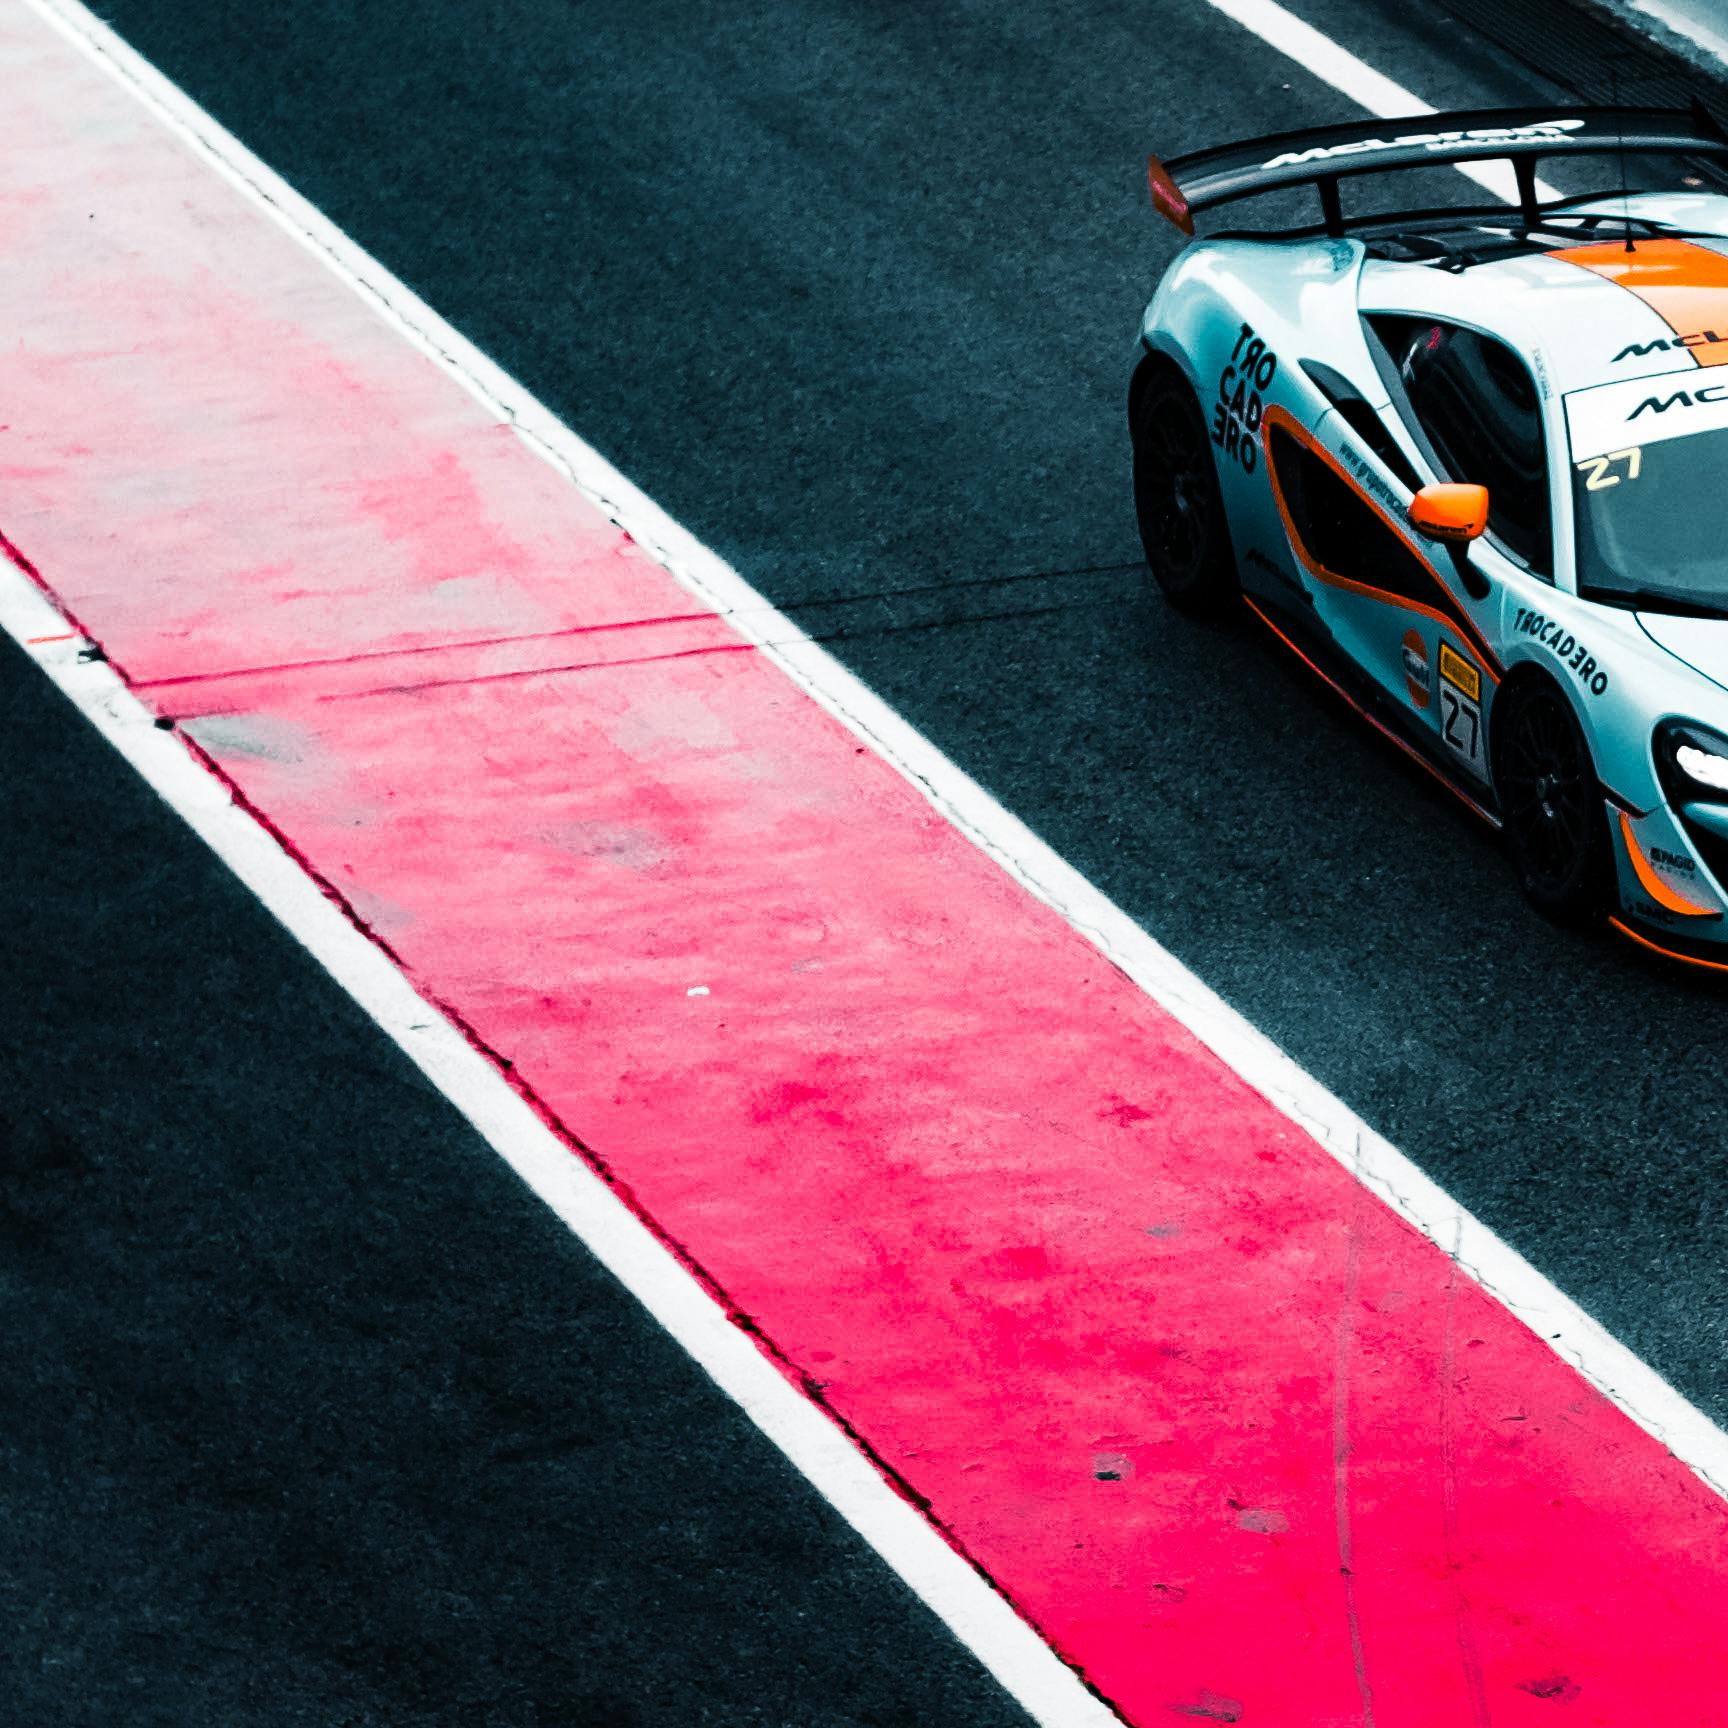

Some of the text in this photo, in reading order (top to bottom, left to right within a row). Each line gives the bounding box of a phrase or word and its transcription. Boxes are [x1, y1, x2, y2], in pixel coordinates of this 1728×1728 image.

[1261, 118, 1586, 169] McLaren
[1219, 364, 1263, 432] CAD
[1577, 446, 1645, 493] 27
[1442, 688, 1478, 759] 27
